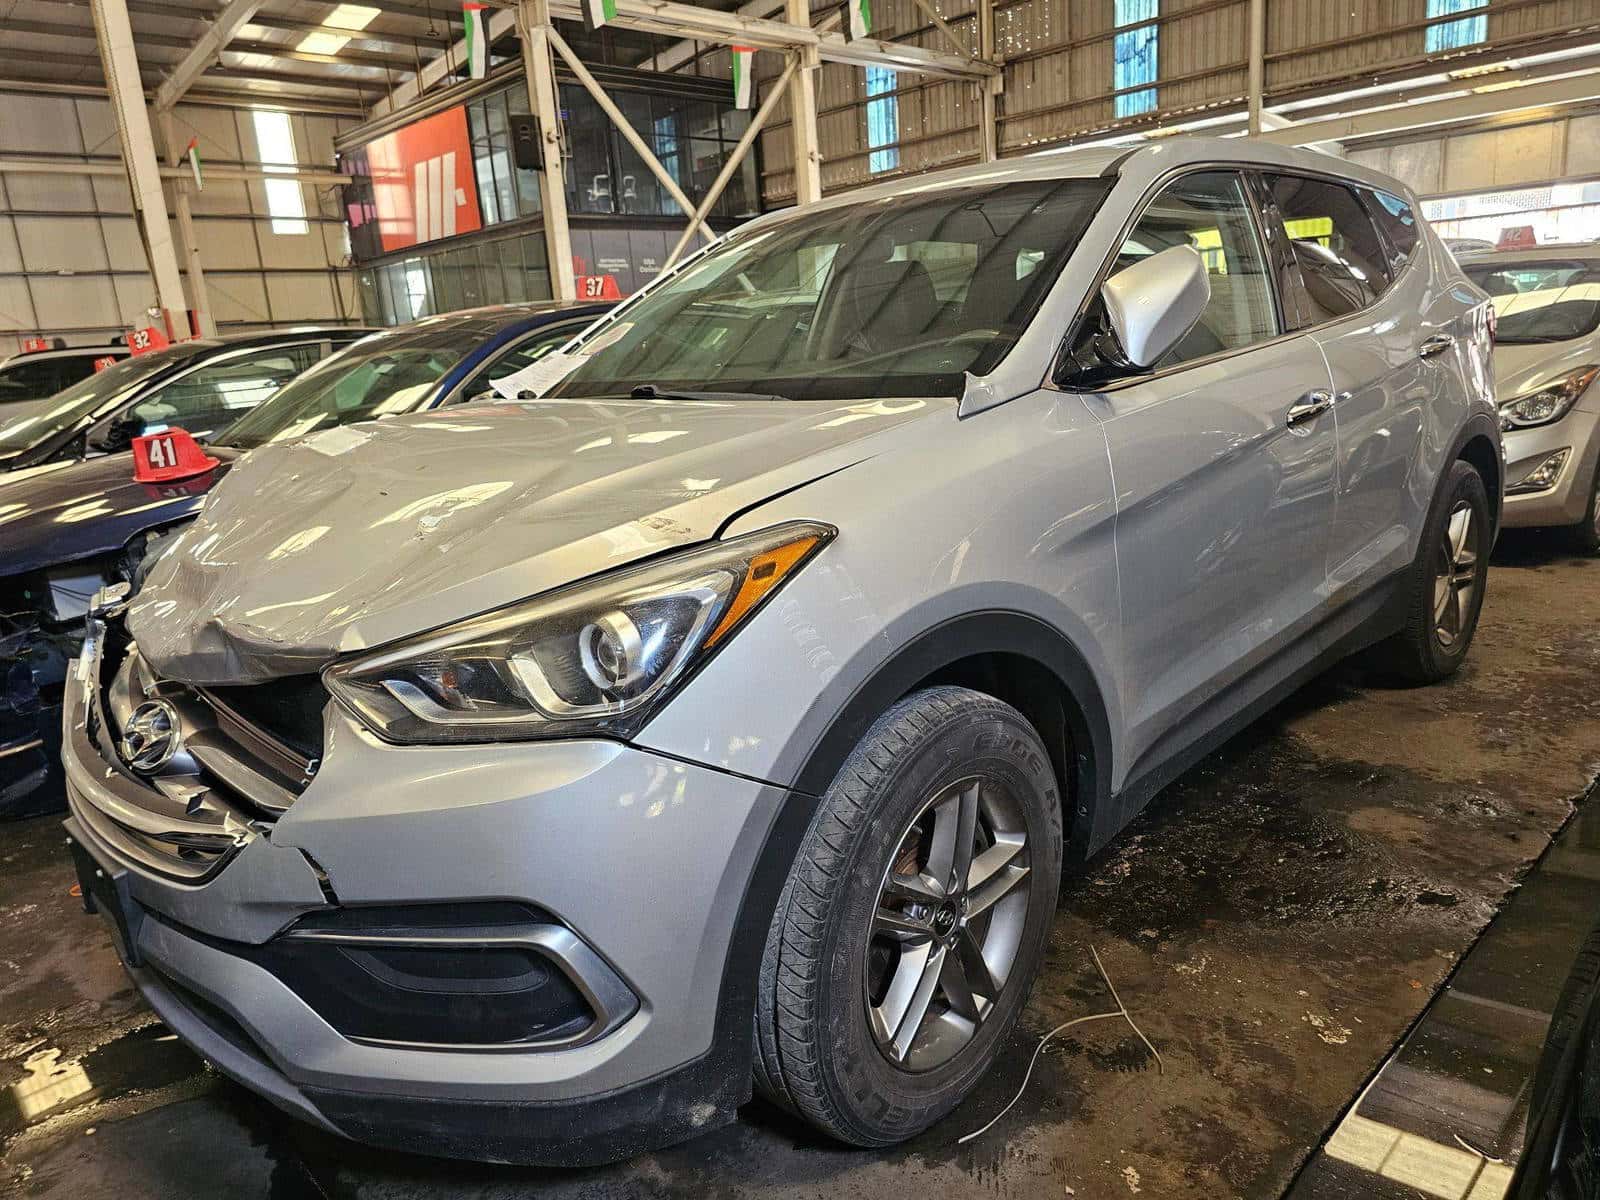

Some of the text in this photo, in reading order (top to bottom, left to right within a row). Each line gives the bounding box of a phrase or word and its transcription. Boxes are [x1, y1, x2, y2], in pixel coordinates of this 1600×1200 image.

[586, 277, 604, 297] 37
[134, 330, 152, 349] 32
[150, 437, 177, 468] 41
